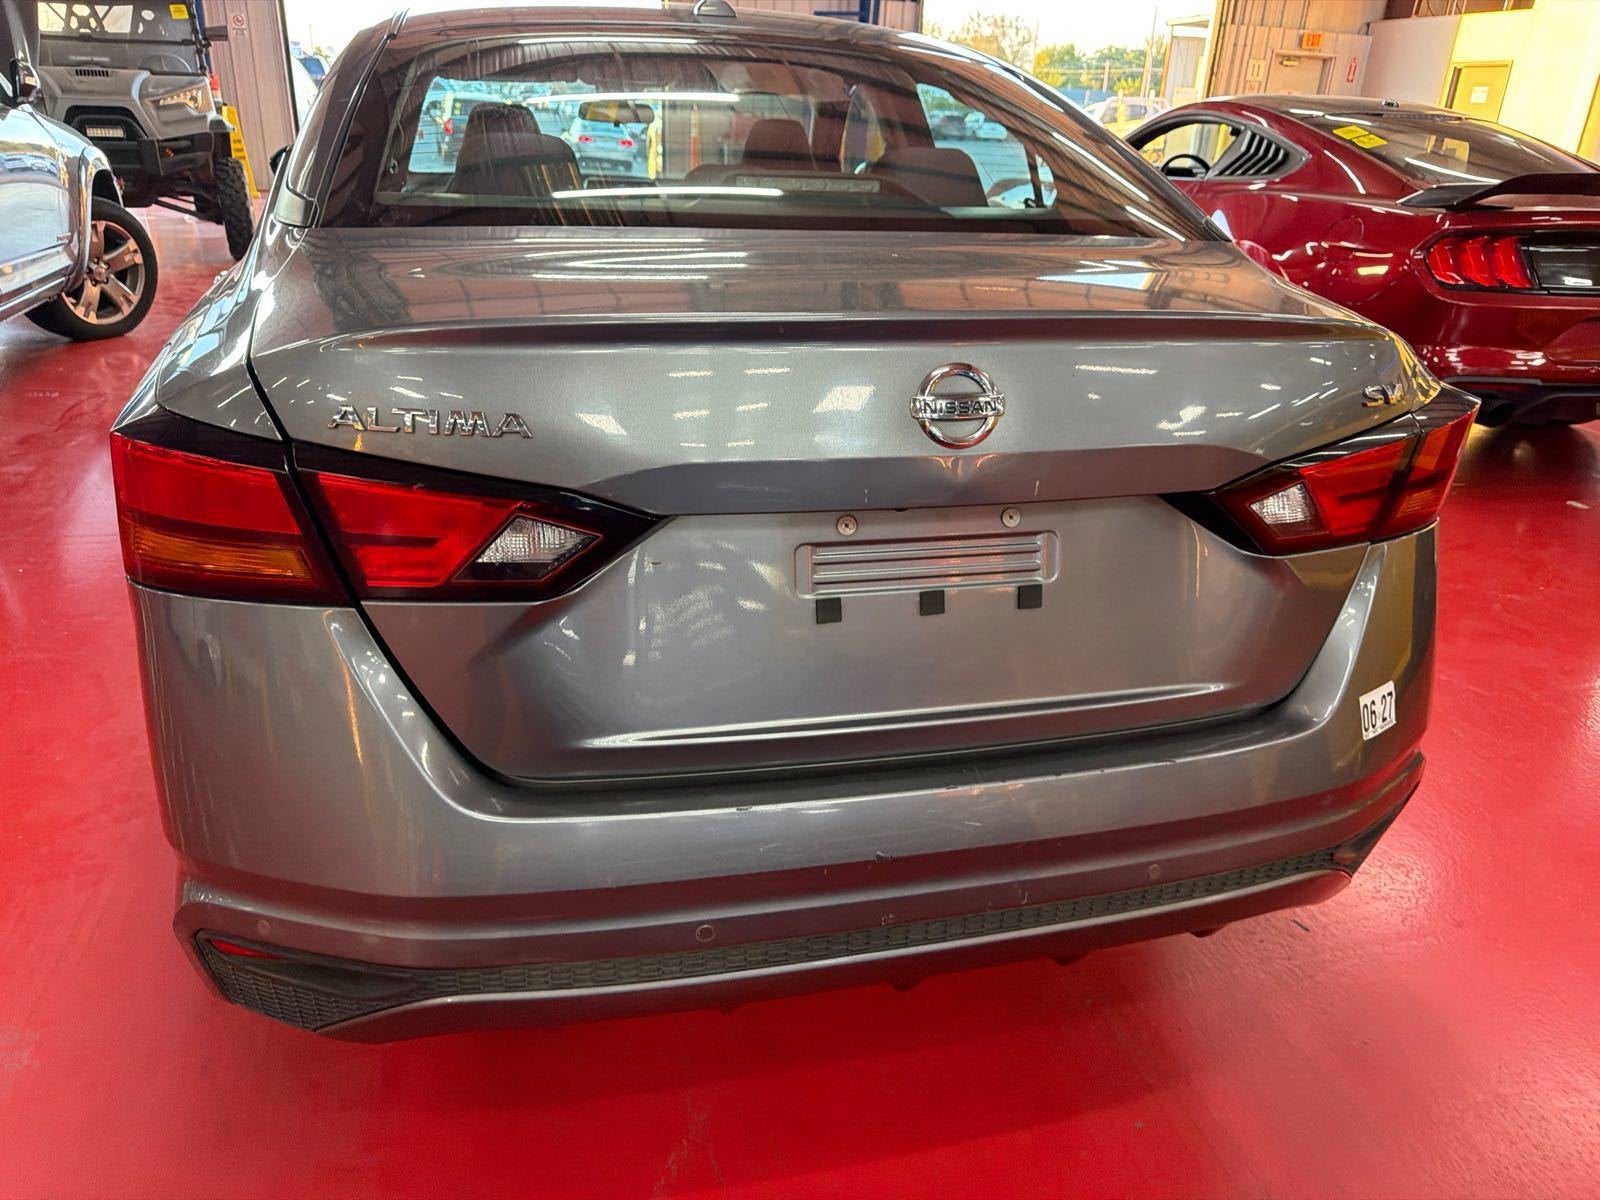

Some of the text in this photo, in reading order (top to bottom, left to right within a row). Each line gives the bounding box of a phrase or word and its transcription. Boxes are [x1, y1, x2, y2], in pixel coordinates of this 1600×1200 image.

[1306, 33, 1321, 47] EXIT
[921, 399, 998, 414] NISSAN
[327, 404, 534, 439] ALTIMA
[1362, 699, 1377, 732] 06
[1380, 691, 1393, 723] 27
